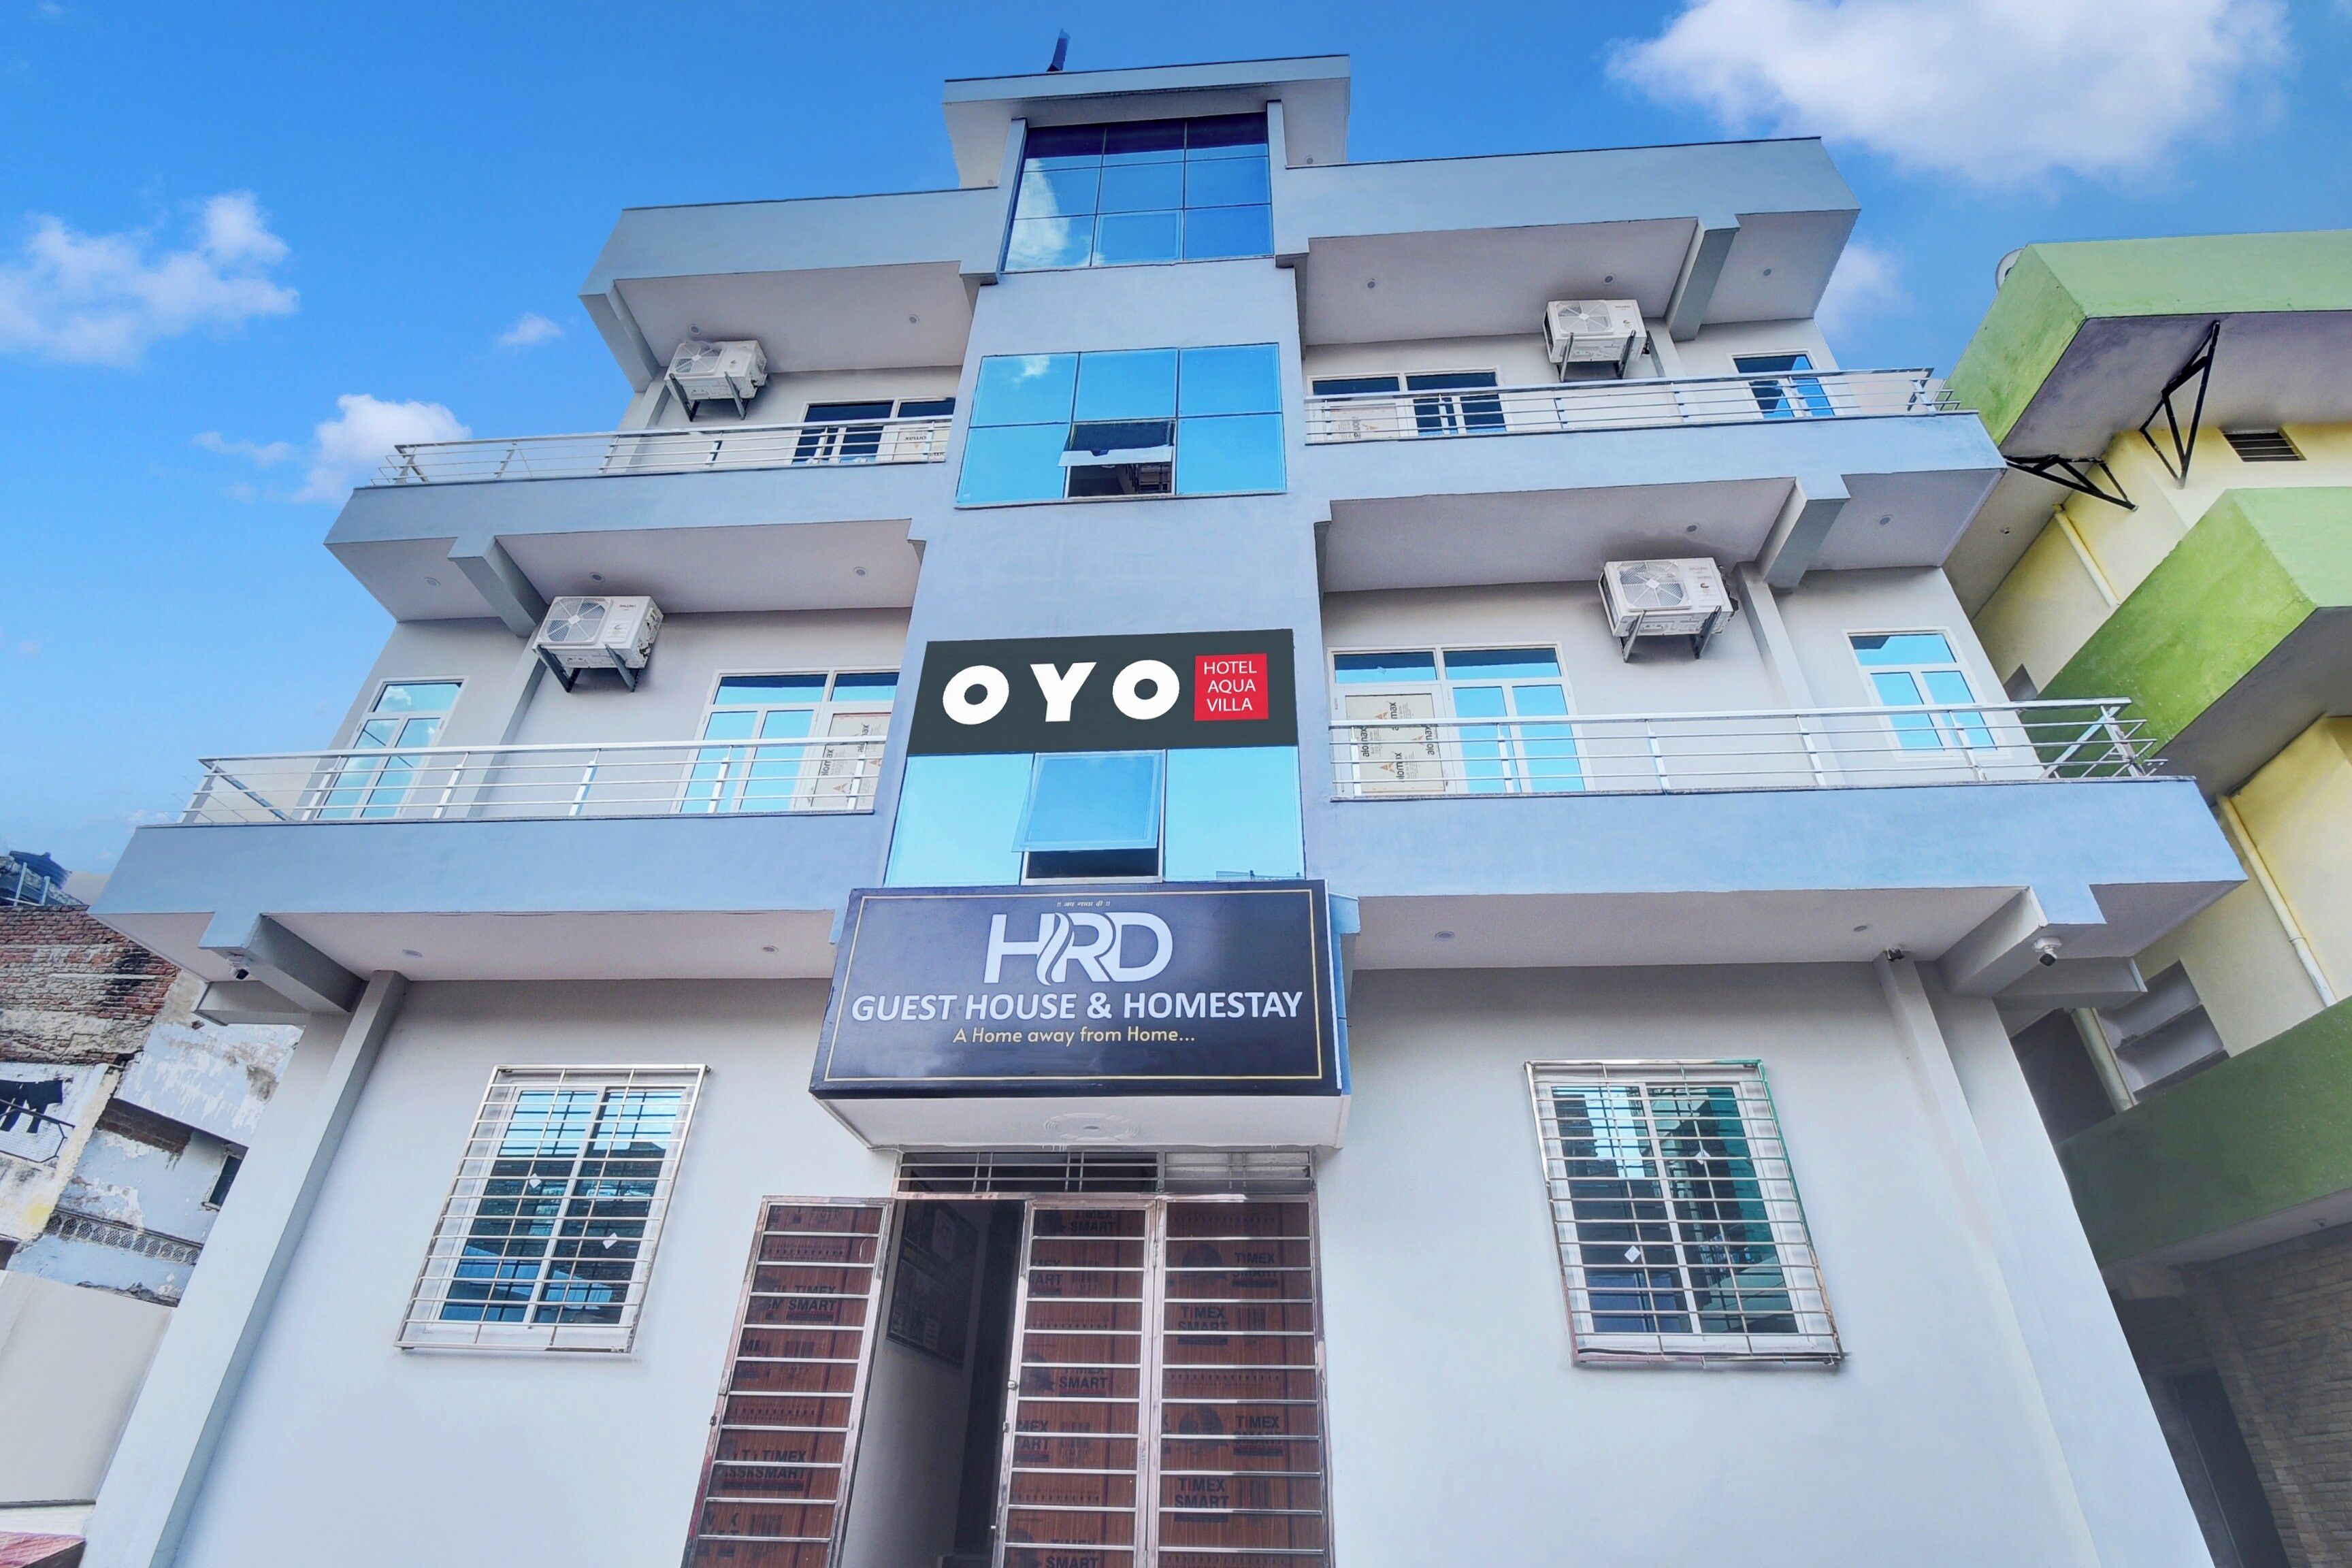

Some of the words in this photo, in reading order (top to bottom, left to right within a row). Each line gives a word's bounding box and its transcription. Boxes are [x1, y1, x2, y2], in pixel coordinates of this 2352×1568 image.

[1204, 661, 1257, 675] HOTEL
[942, 659, 1180, 725] OYO
[1207, 679, 1256, 694] AQUA
[1207, 698, 1253, 712] VILLA
[983, 912, 1173, 986] HRD
[852, 995, 958, 1022] GUEST
[965, 994, 1077, 1020] HOUSE
[1088, 992, 1112, 1019] &
[1124, 992, 1303, 1018] HOMESTAY
[953, 1028, 967, 1043] A
[972, 1027, 1022, 1043] Home
[1028, 1031, 1075, 1047] away
[1080, 1026, 1122, 1042] from
[1128, 1026, 1195, 1042] Home...
[1071, 1221, 1115, 1232] SMART
[1235, 1252, 1275, 1264] TIMEX
[787, 1298, 837, 1311] SMART
[1181, 1306, 1225, 1319] TIMEX
[1059, 1376, 1108, 1389] SMART
[1235, 1415, 1279, 1428] TIMEX
[1178, 1477, 1226, 1492] TIMEX
[1174, 1494, 1229, 1508] SMART
